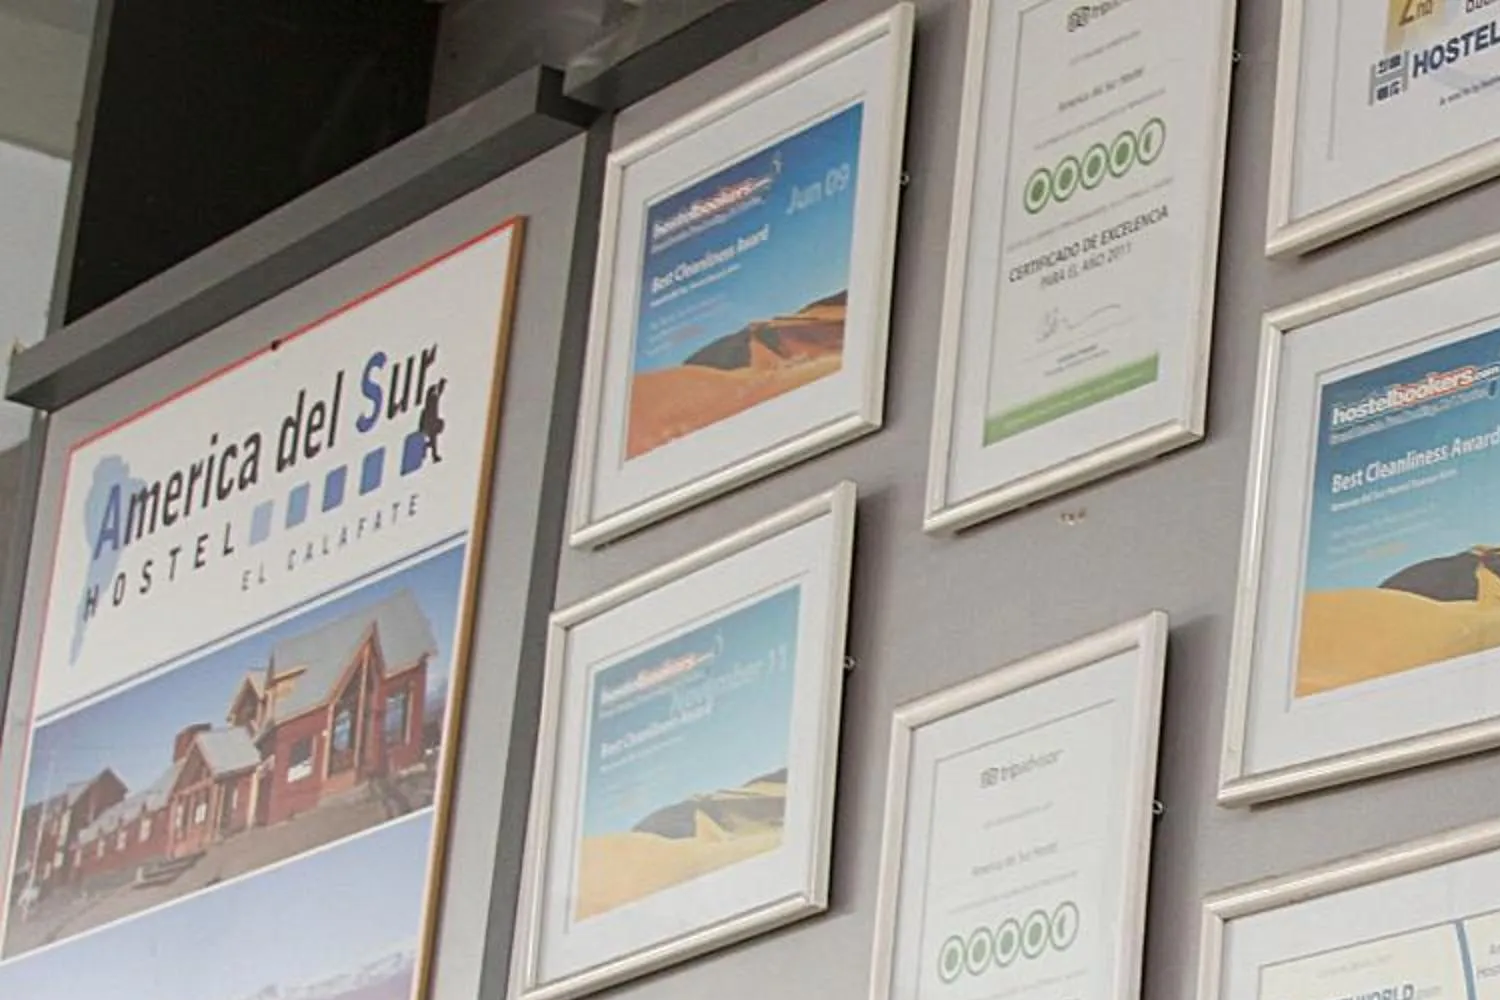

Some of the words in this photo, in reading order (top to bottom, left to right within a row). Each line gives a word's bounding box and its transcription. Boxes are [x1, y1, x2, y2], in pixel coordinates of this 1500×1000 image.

[785, 181, 822, 216] Jun
[825, 162, 851, 197] 09
[1008, 241, 1080, 282] CERTIFICADO
[1081, 233, 1099, 252] DE
[93, 430, 263, 562] America
[276, 369, 345, 473] del
[355, 344, 439, 434] Sur
[1331, 469, 1364, 494] Best
[1364, 445, 1449, 482] Cleanliness
[83, 521, 235, 624] HOSTEL
[241, 562, 267, 592] EL
[287, 493, 420, 572] CALAFATE
